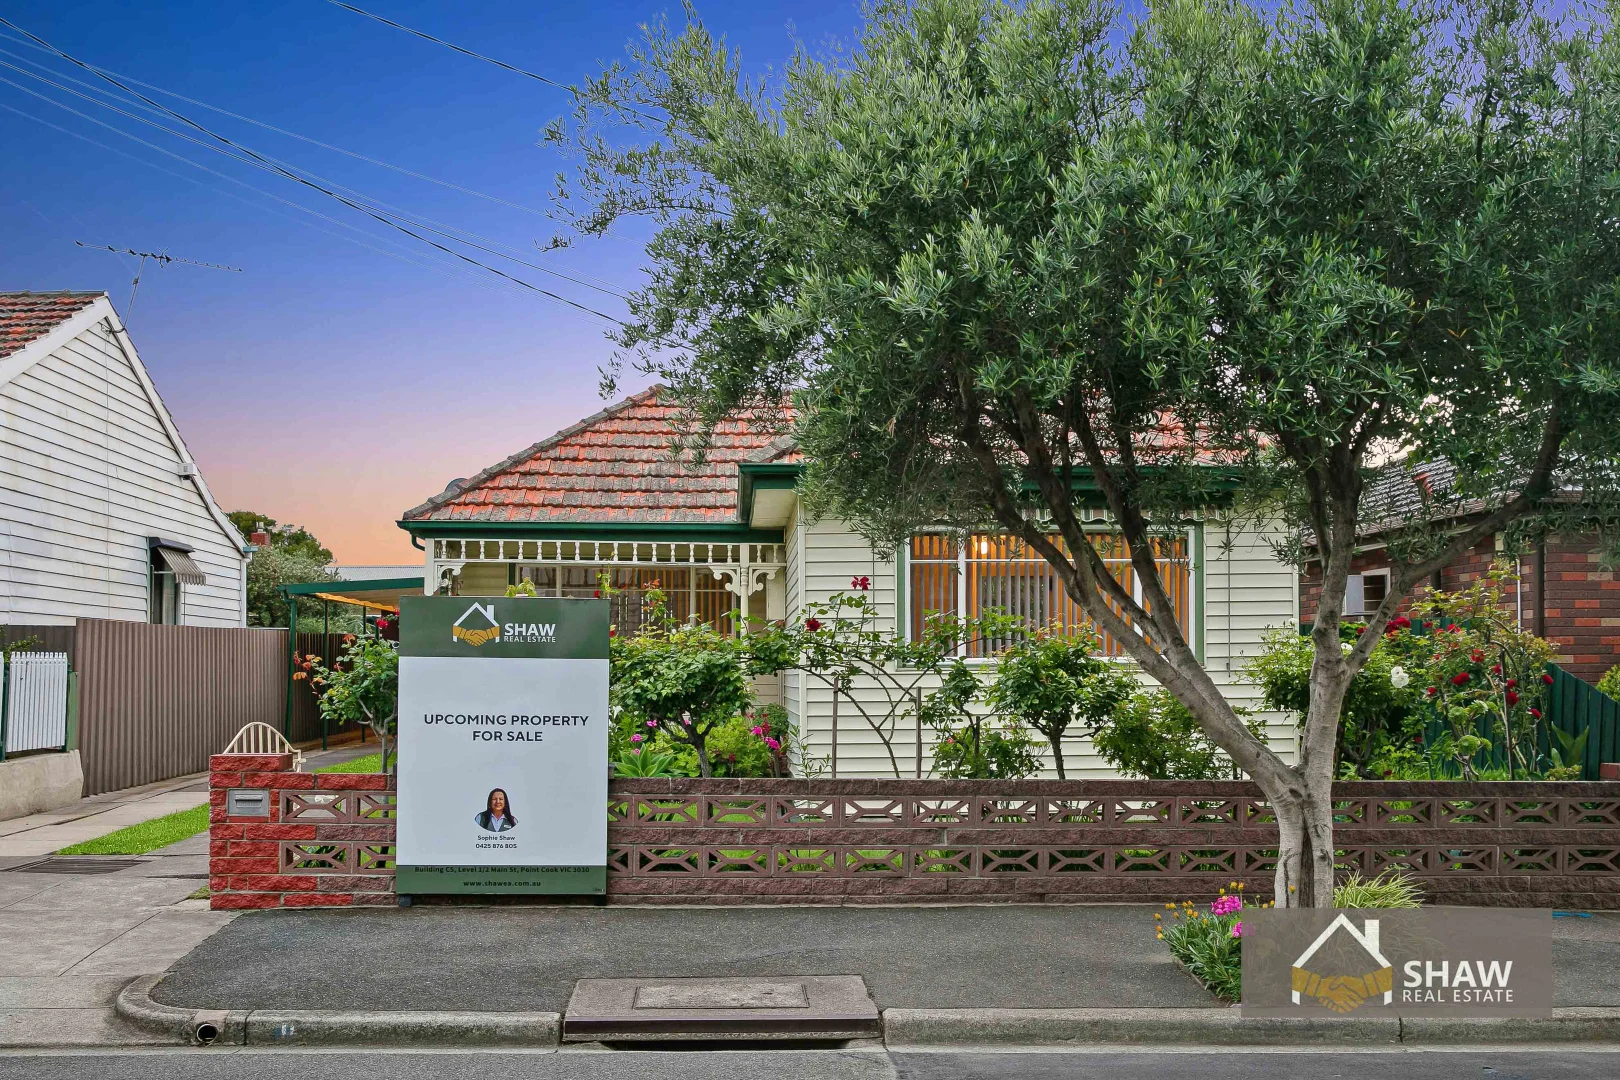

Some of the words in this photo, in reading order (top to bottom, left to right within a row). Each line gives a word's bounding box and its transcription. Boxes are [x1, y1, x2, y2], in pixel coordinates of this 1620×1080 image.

[504, 623, 556, 636] SHAW
[424, 714, 507, 726] UPCOMING
[511, 714, 589, 727] PROPERTY
[473, 730, 503, 741] FOR
[507, 730, 543, 742] SALE
